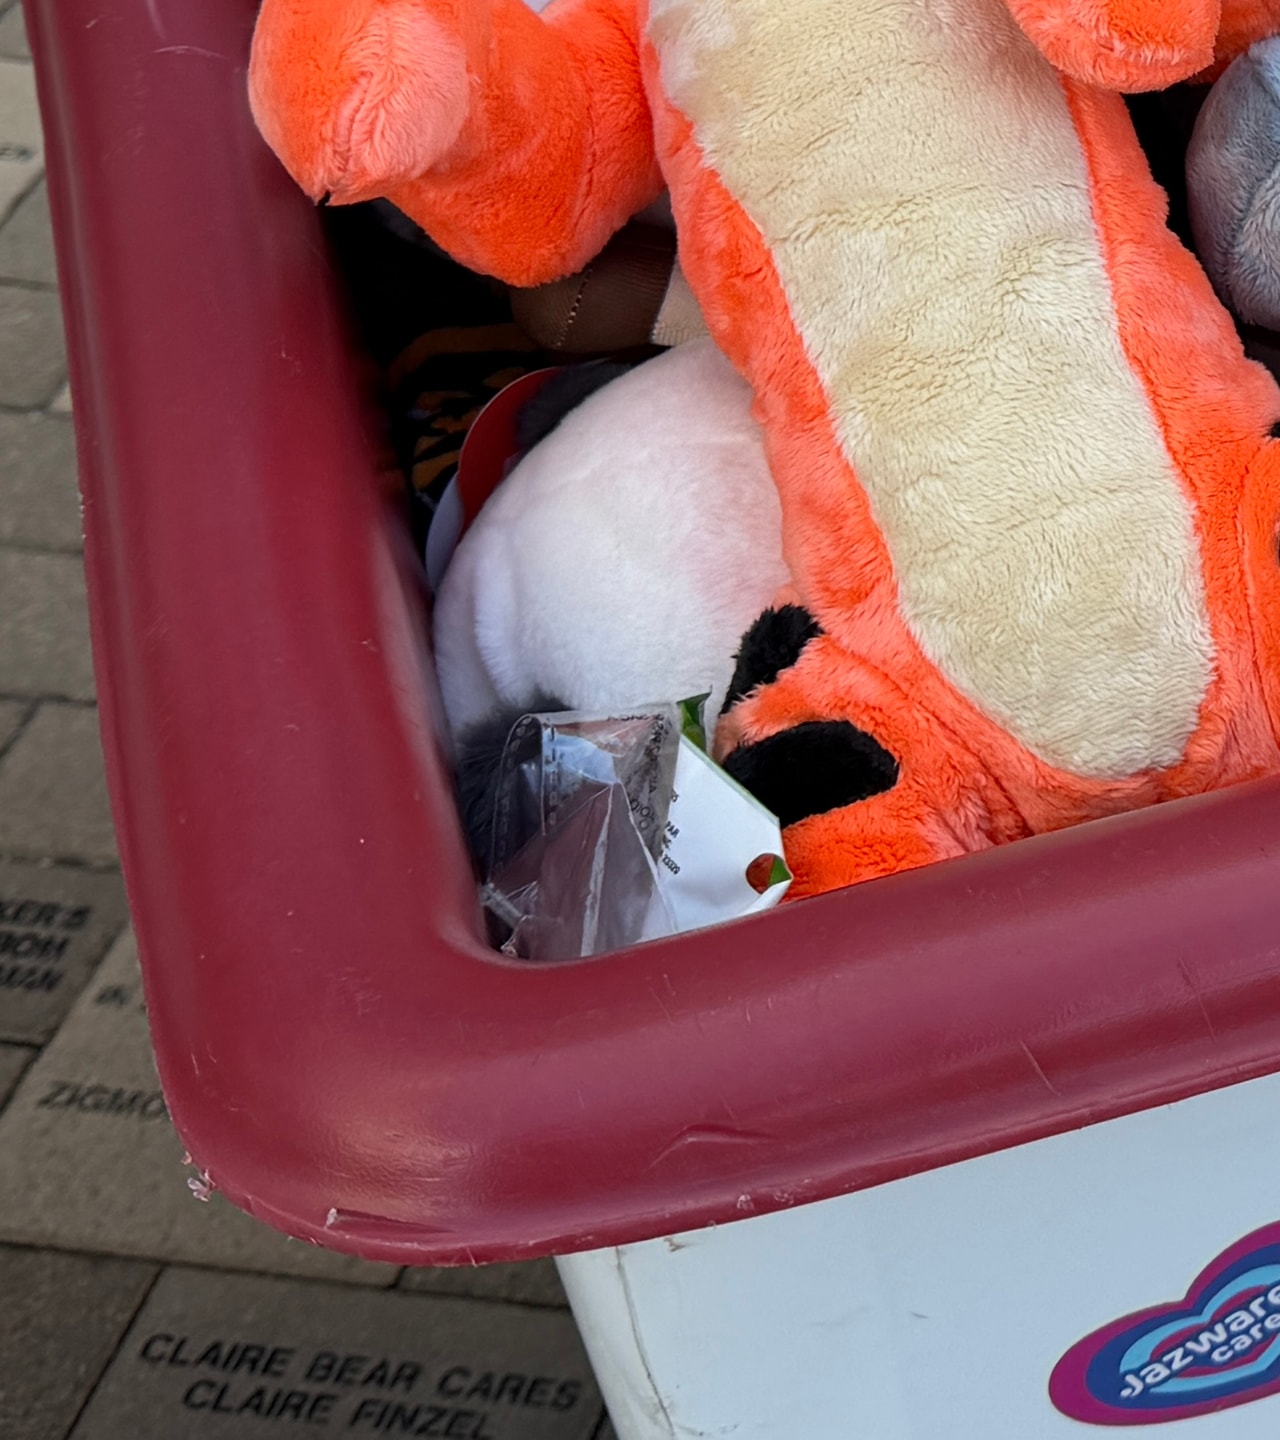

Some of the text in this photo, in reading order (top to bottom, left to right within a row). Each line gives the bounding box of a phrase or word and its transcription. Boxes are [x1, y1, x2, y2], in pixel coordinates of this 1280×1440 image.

[38, 1080, 172, 1122] ZIGMO
[139, 1332, 584, 1413] CLAIRE BEAR CARES
[182, 1378, 501, 1440] CLAIRE FINZEL
